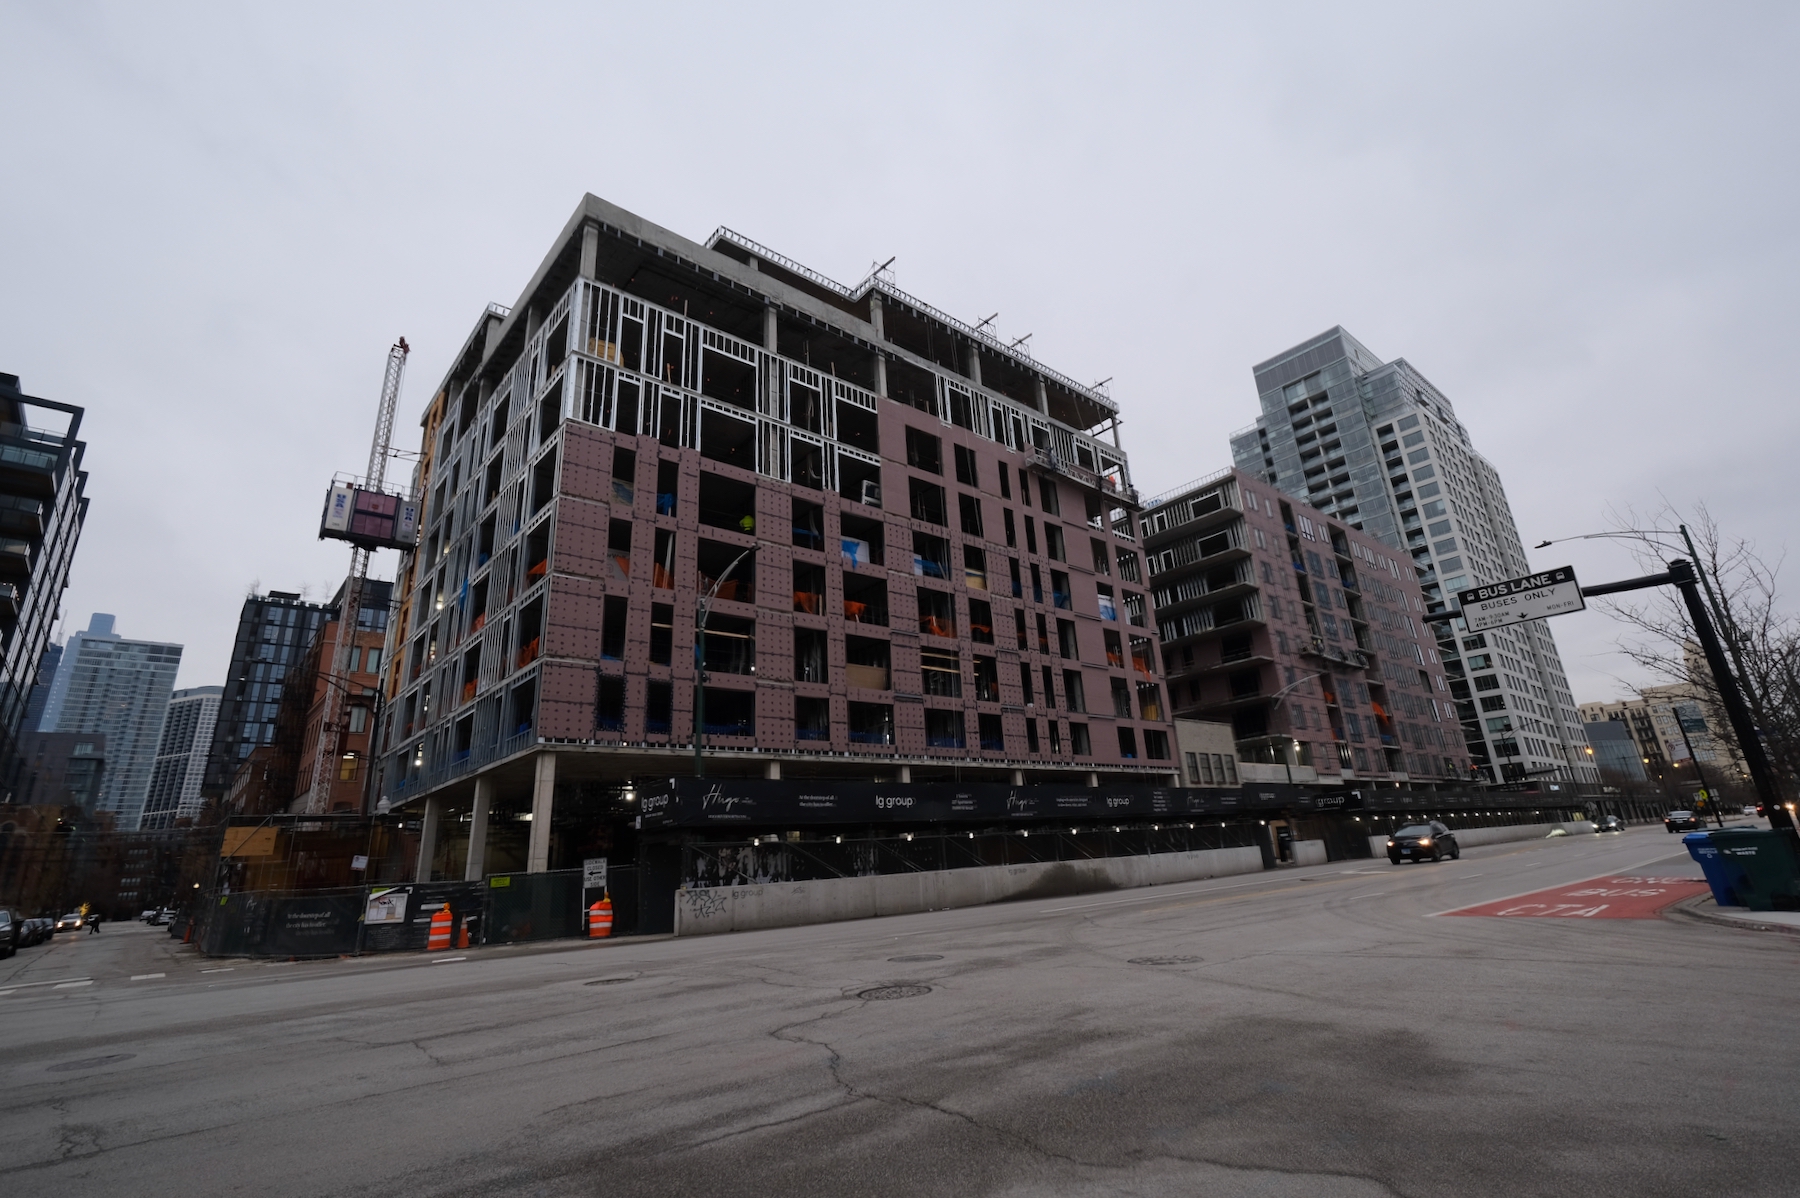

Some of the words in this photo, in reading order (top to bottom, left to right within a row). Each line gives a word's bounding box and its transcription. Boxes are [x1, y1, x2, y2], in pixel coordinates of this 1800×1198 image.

[1478, 584, 1508, 599] BUS
[1510, 574, 1552, 592] LANE
[1481, 597, 1518, 611] BUSES
[1524, 588, 1556, 601] ONLY
[1547, 601, 1575, 610] MON-FRI
[648, 794, 669, 811] group
[886, 797, 914, 808] group
[1113, 797, 1130, 807] group
[741, 889, 764, 899] group
[1563, 888, 1666, 897] BUS
[1496, 904, 1610, 917] CTA
